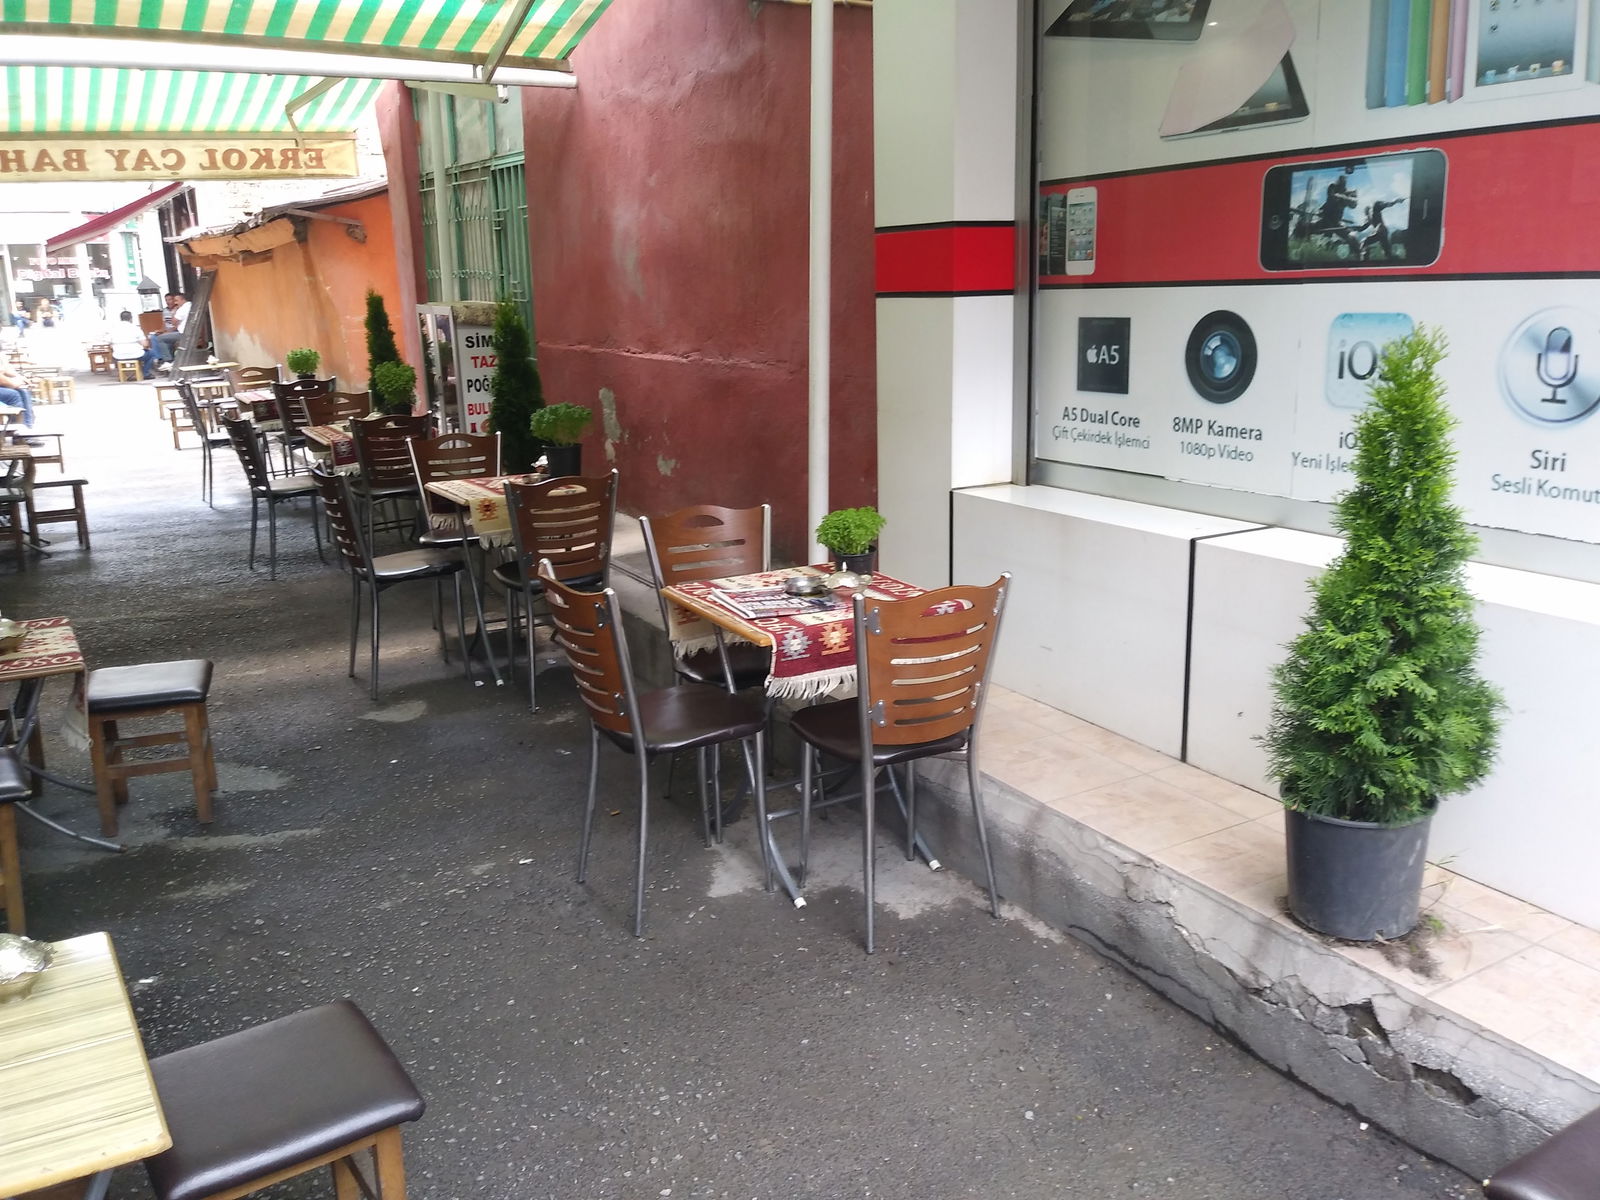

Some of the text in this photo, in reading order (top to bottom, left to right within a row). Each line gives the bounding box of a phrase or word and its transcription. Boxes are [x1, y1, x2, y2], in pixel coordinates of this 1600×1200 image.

[465, 332, 496, 349] SİM
[1098, 344, 1120, 365] A5
[1062, 406, 1140, 428] A5 Dual Core
[1052, 425, 1069, 441] Çift
[1070, 427, 1113, 445] Çekirdek
[1172, 416, 1263, 441] 8MP Kamera
[1180, 441, 1254, 462] 1080p Video
[1291, 451, 1322, 469] Yeni
[1529, 449, 1567, 472] Siri
[1491, 473, 1533, 495] Sesli
